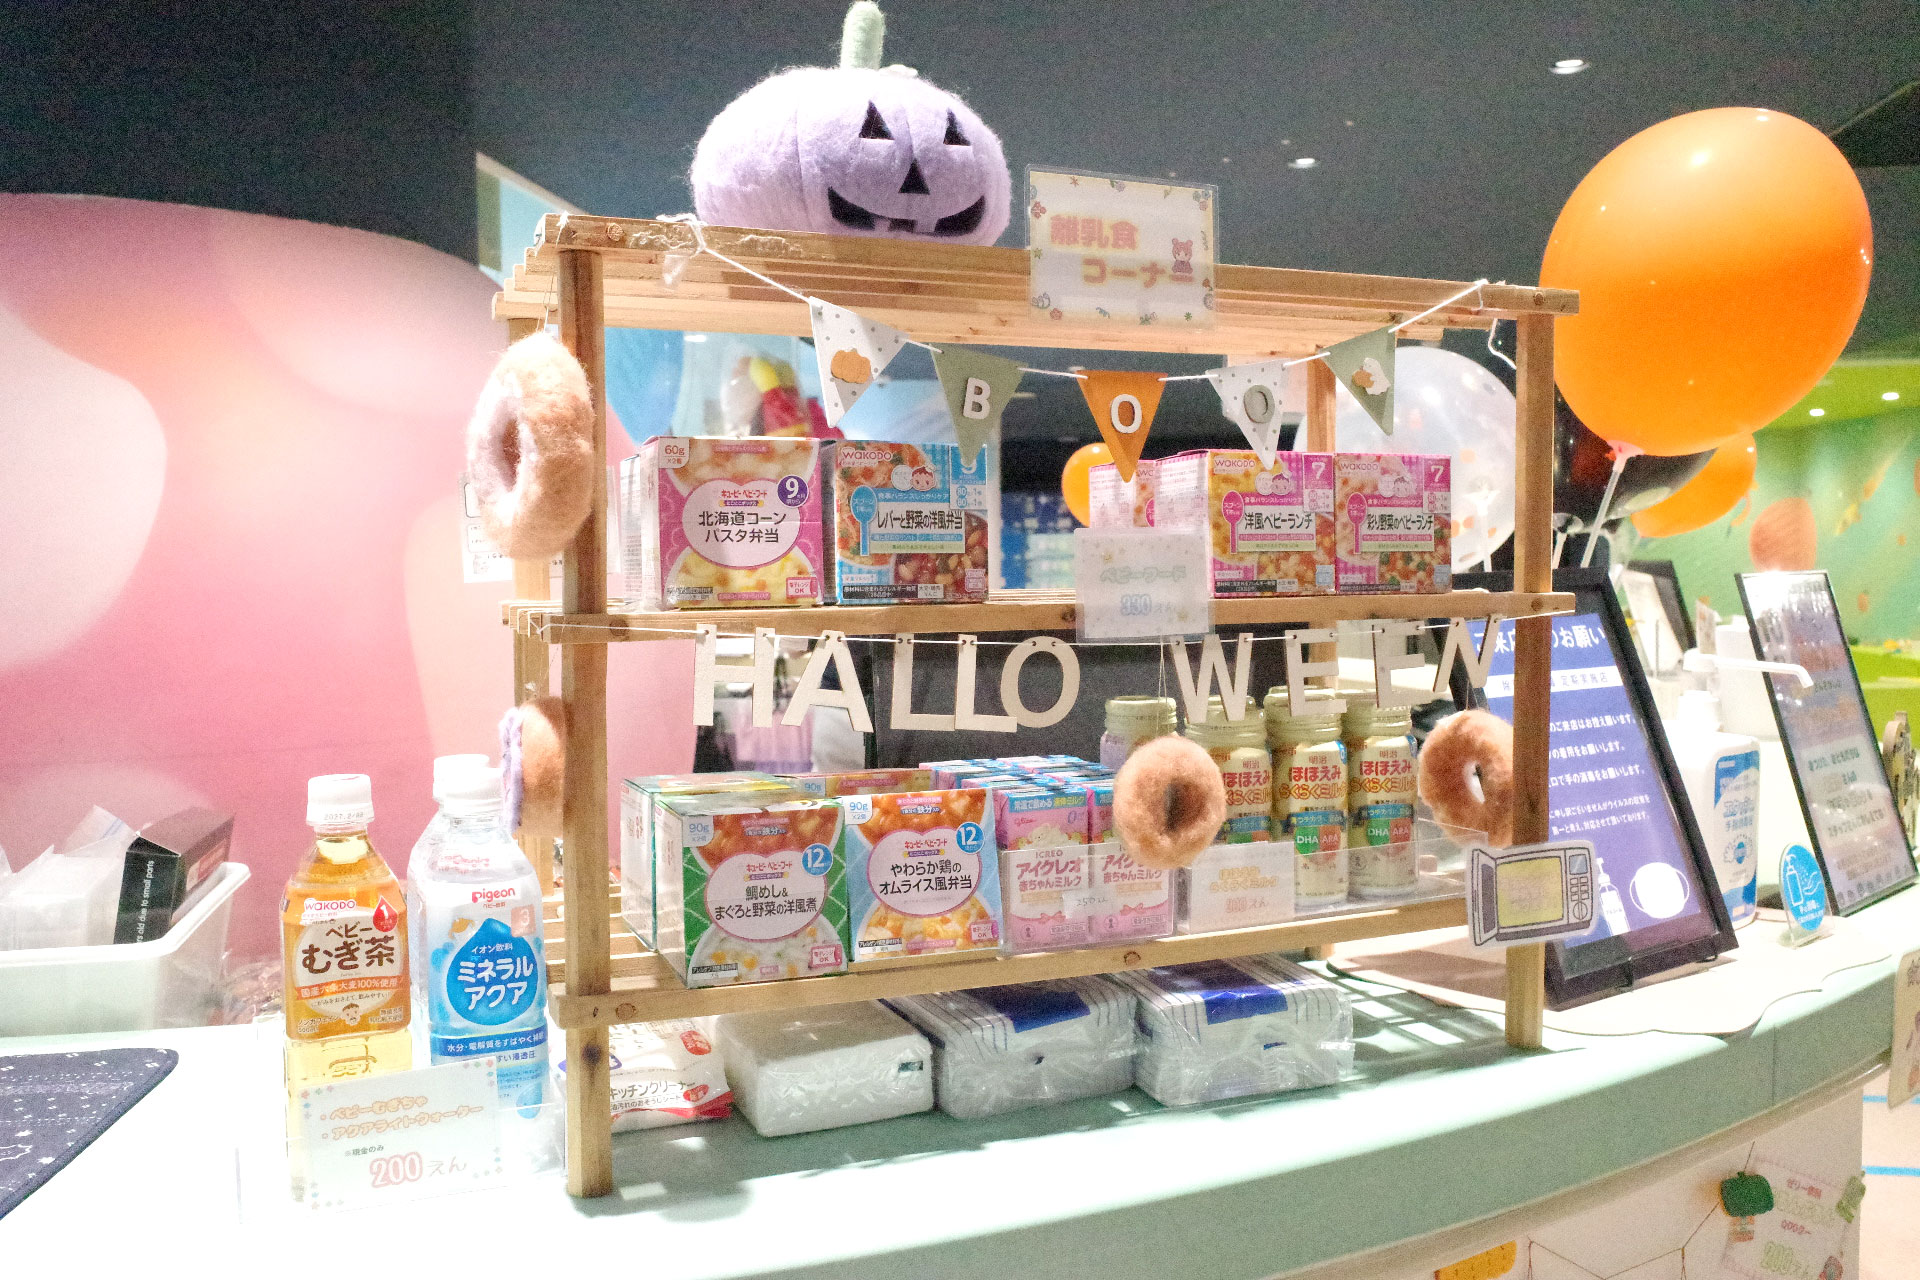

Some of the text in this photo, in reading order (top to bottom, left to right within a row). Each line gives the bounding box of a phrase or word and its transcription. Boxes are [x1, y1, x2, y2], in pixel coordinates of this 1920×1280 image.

[664, 444, 685, 456] 60g
[1312, 463, 1325, 480] 7
[1430, 466, 1443, 482] 7
[785, 477, 799, 497] 9
[699, 511, 786, 527] 北海道コーン
[877, 510, 963, 529] レバーと野菜の洋風弁当
[1244, 511, 1313, 530] 洋風ベビーランチ
[1366, 512, 1434, 531] 彩り野菜のベビーランチ
[704, 528, 779, 543] パスタ弁当
[1289, 765, 1342, 783] ほほえみ
[1360, 760, 1412, 776] ほほえみ
[850, 802, 869, 811] 90g
[689, 823, 710, 834] 90g
[959, 827, 977, 846] 12
[1366, 828, 1389, 837] DHA
[1296, 834, 1319, 845] DHA
[806, 848, 824, 869] 12
[1035, 850, 1063, 858] ICREO
[146, 860, 155, 879] parts
[890, 861, 962, 878] やわらか鶏の
[1016, 857, 1085, 879] アイクレオ
[1103, 869, 1163, 884] 赤ちゃんミルク
[142, 879, 151, 898] small
[745, 883, 789, 901] 鯛めし&
[879, 875, 973, 894] オムライス風弁当
[1019, 875, 1082, 892] 赤ちゃんミルク
[140, 899, 149, 907] to
[714, 898, 818, 921] まぐろと野菜の洋風煮
[138, 908, 147, 922] due
[519, 908, 529, 926] 3
[136, 922, 145, 935] old
[326, 921, 373, 939] ベビー
[302, 935, 395, 975] むぎ茶
[471, 943, 513, 955] イオン飲料
[457, 955, 534, 983] ミネラル
[464, 982, 529, 1011] アクア
[331, 1105, 484, 1140] アクアライトウォーター
